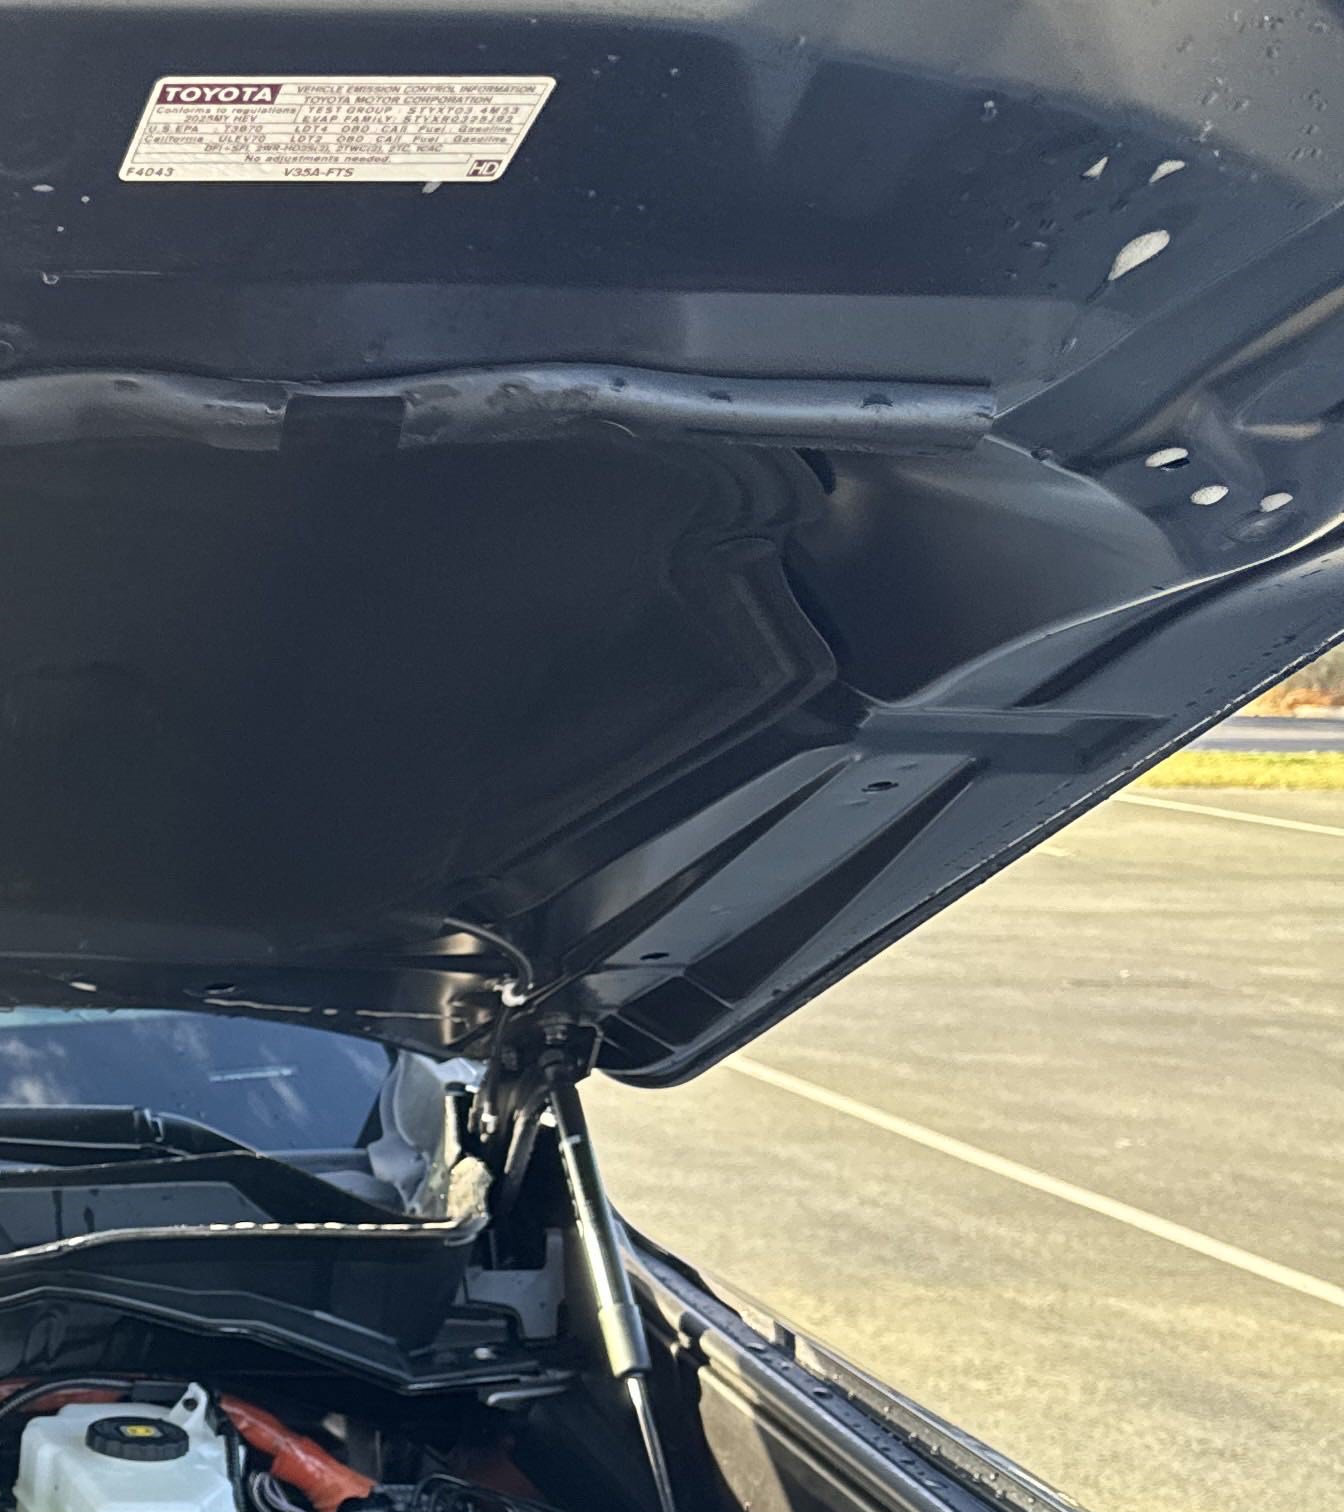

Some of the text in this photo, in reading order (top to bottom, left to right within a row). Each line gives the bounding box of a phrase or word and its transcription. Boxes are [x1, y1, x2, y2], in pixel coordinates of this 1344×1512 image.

[164, 86, 274, 102] TOYOTA
[304, 96, 350, 104] TOYOTA
[354, 96, 401, 104] MOTOR
[216, 106, 225, 114] to
[231, 106, 297, 115] regulations
[308, 106, 342, 114] TEST
[346, 106, 393, 114] GROUP
[233, 115, 258, 123] HEV
[302, 115, 338, 123] EVAP
[265, 155, 339, 164] adjustments
[126, 167, 175, 177] F4043
[468, 161, 500, 176] HD
